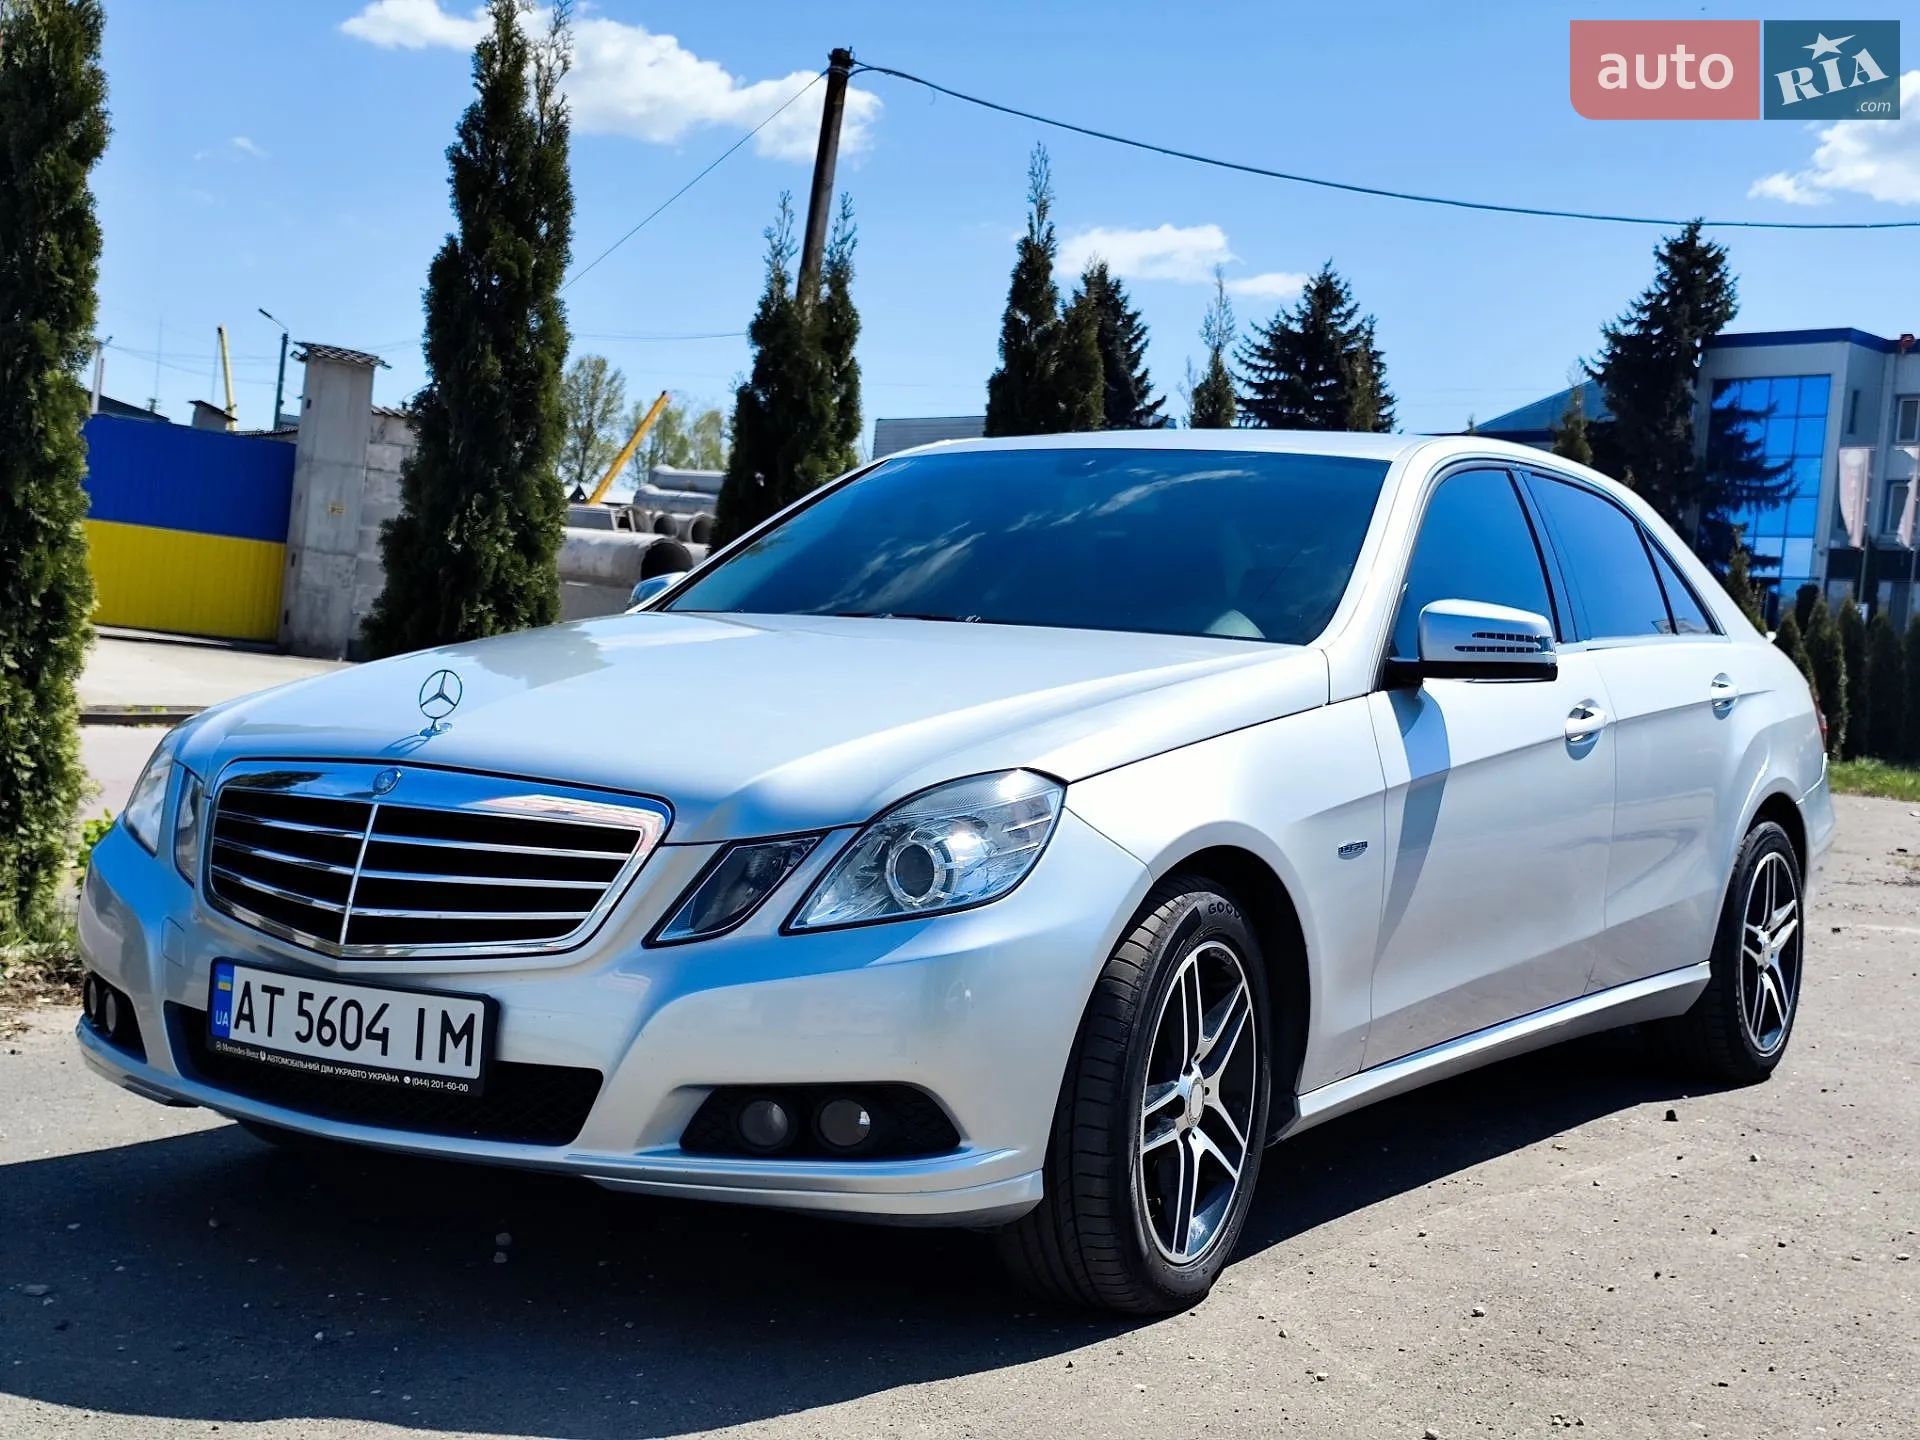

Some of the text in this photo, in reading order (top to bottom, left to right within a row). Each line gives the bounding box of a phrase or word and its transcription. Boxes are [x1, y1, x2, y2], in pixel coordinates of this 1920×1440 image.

[215, 1010, 229, 1027] UA
[233, 980, 475, 1067] AT 5604 IM
[222, 1042, 260, 1059] Mercedes-Benz
[266, 1054, 469, 1093] АВТОМОБІЛЬНИЙ ДІМ УКРАВТО УКРАЇНА (044) 201-60-00
